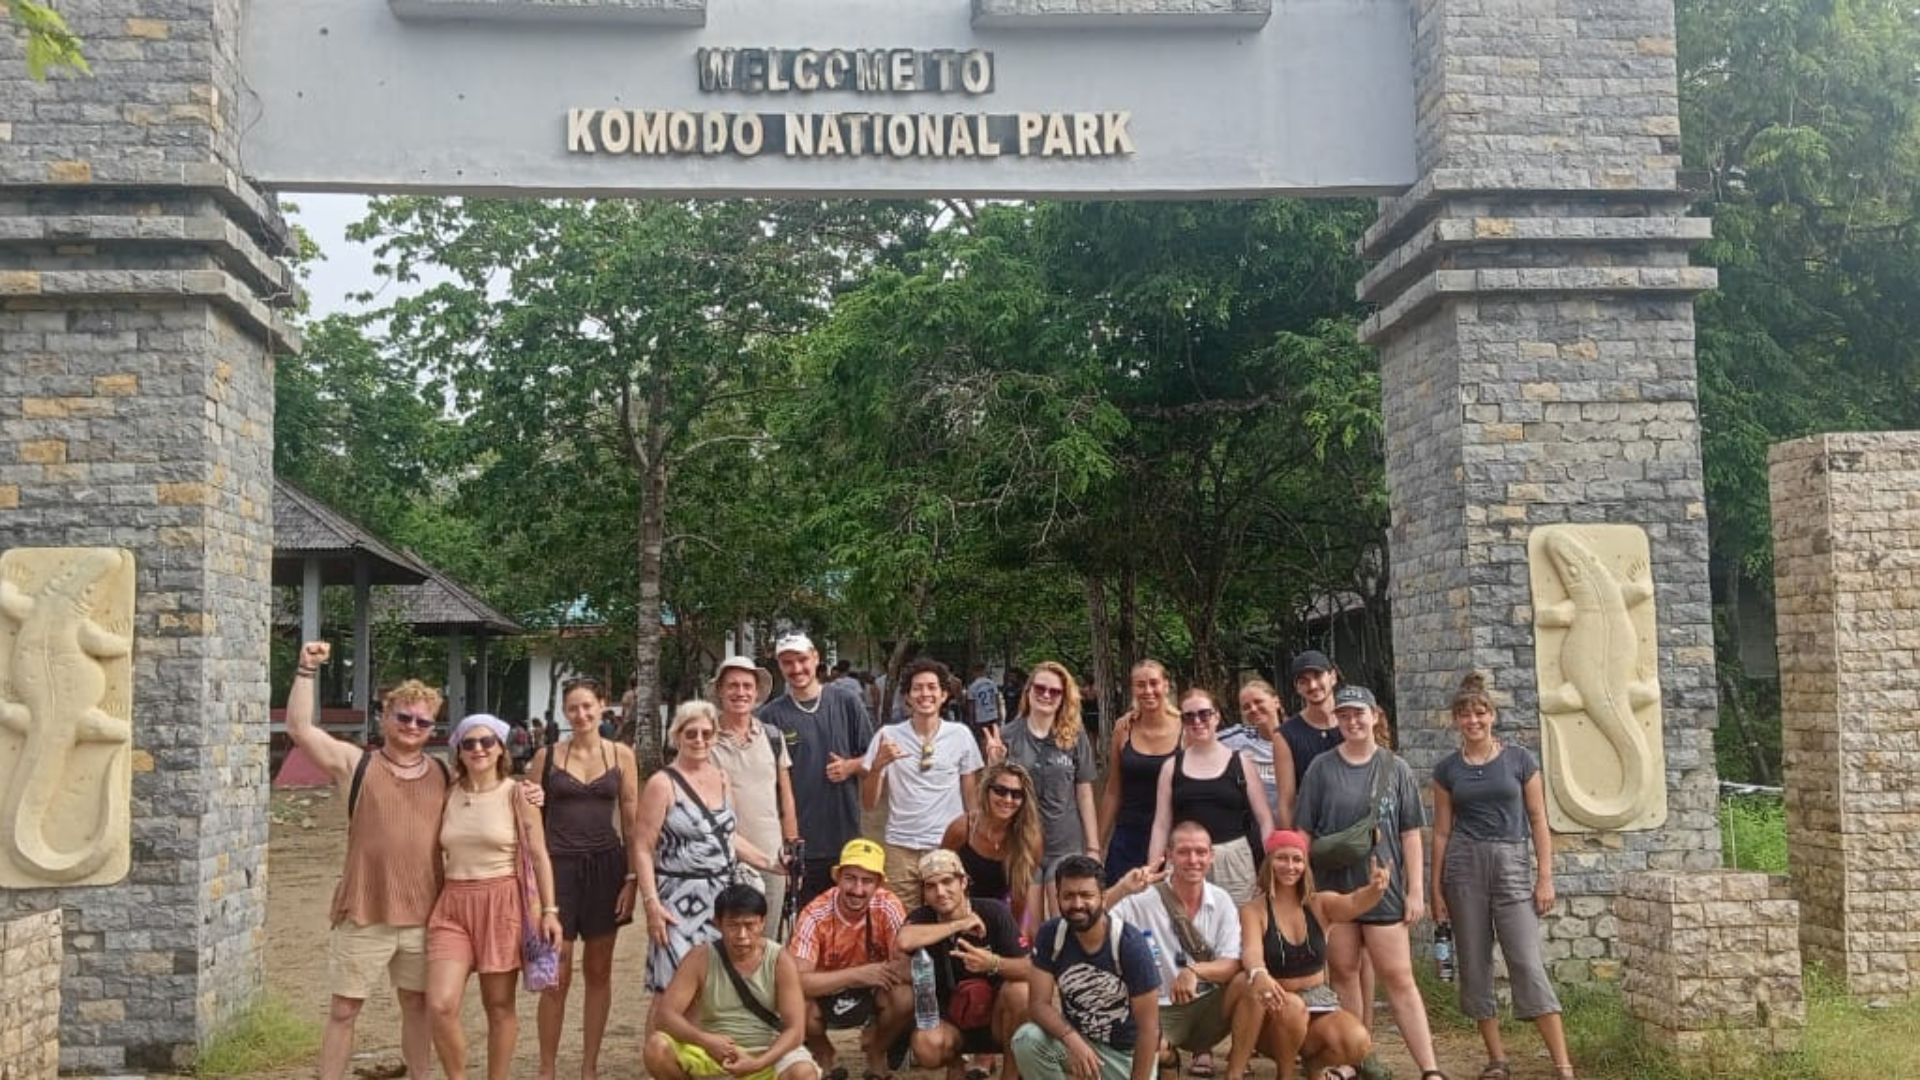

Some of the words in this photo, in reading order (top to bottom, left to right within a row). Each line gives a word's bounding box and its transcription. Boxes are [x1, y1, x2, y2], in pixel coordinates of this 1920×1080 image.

[699, 47, 918, 93] WELCOME
[931, 48, 992, 94] TO
[567, 107, 764, 156] KOMODO
[784, 111, 1000, 157] NATIONAL
[1017, 111, 1136, 157] PARK
